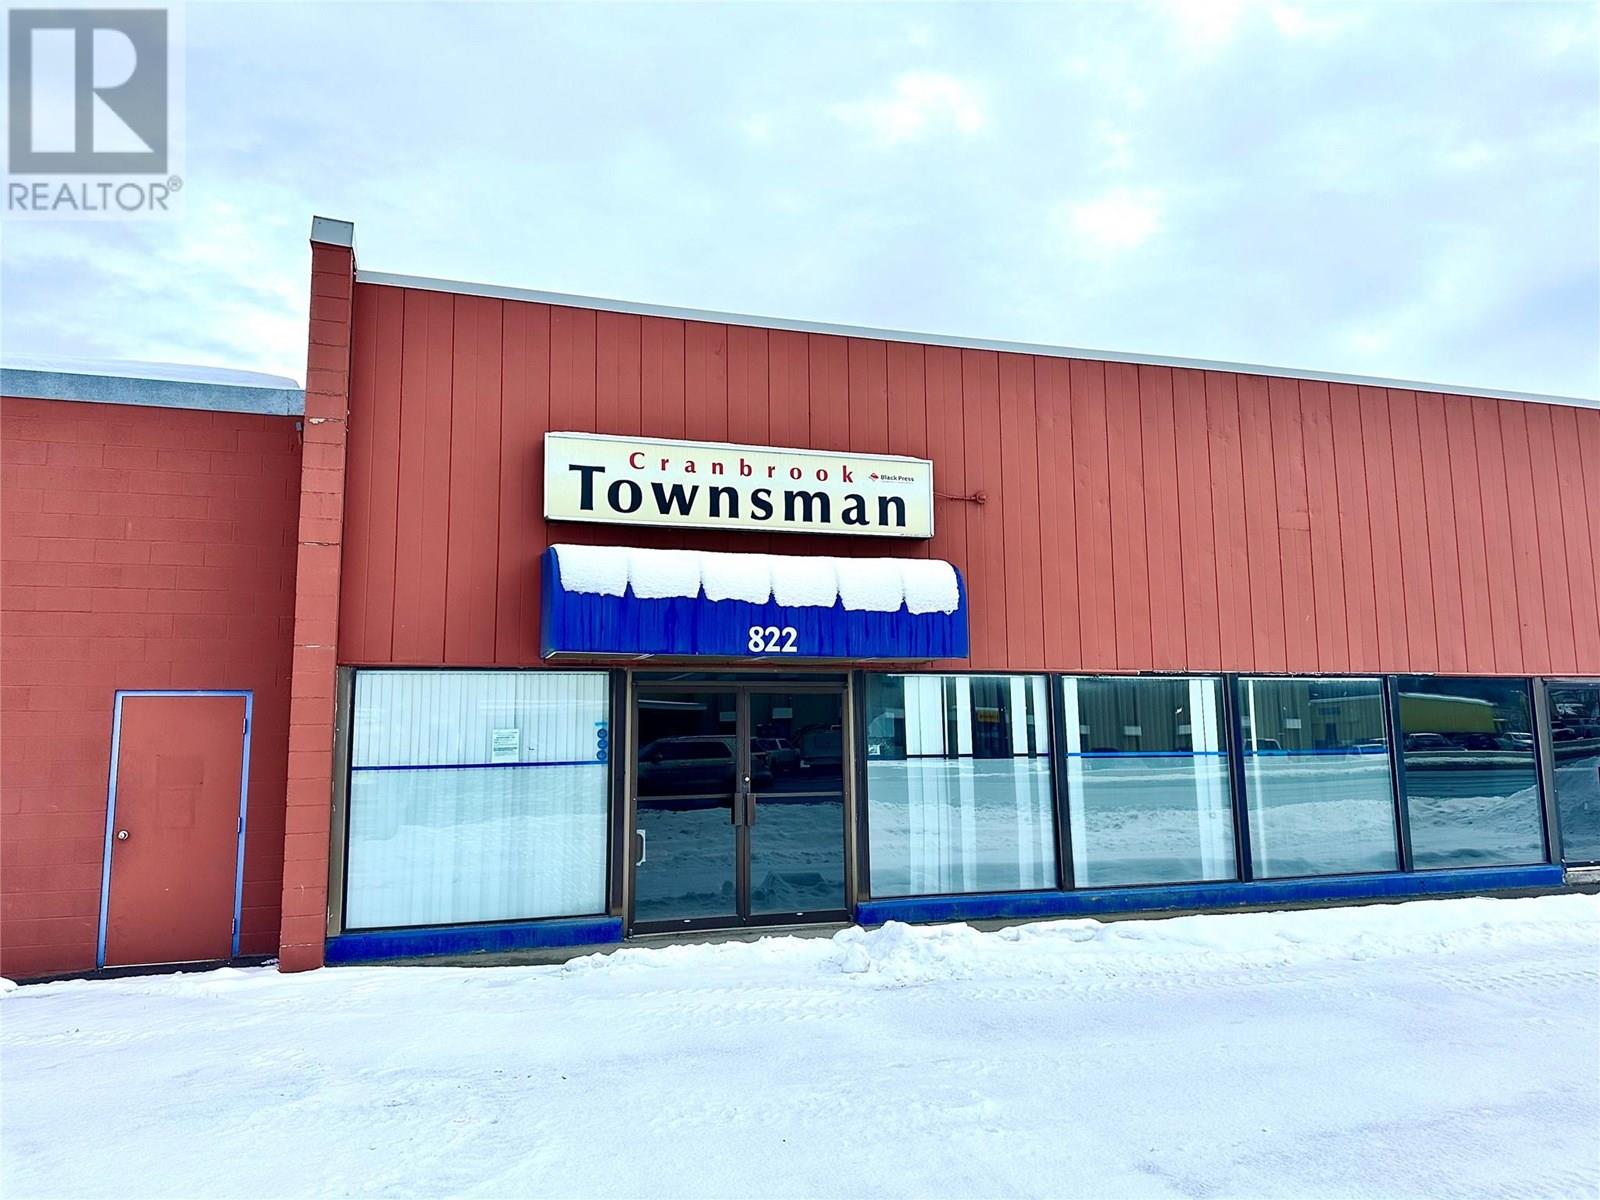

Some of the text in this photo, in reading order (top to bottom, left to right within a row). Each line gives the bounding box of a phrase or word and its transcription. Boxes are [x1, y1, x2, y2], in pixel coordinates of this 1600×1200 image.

[629, 451, 854, 483] Cranbrook
[569, 463, 906, 527] Townsman
[747, 626, 798, 653] 822
